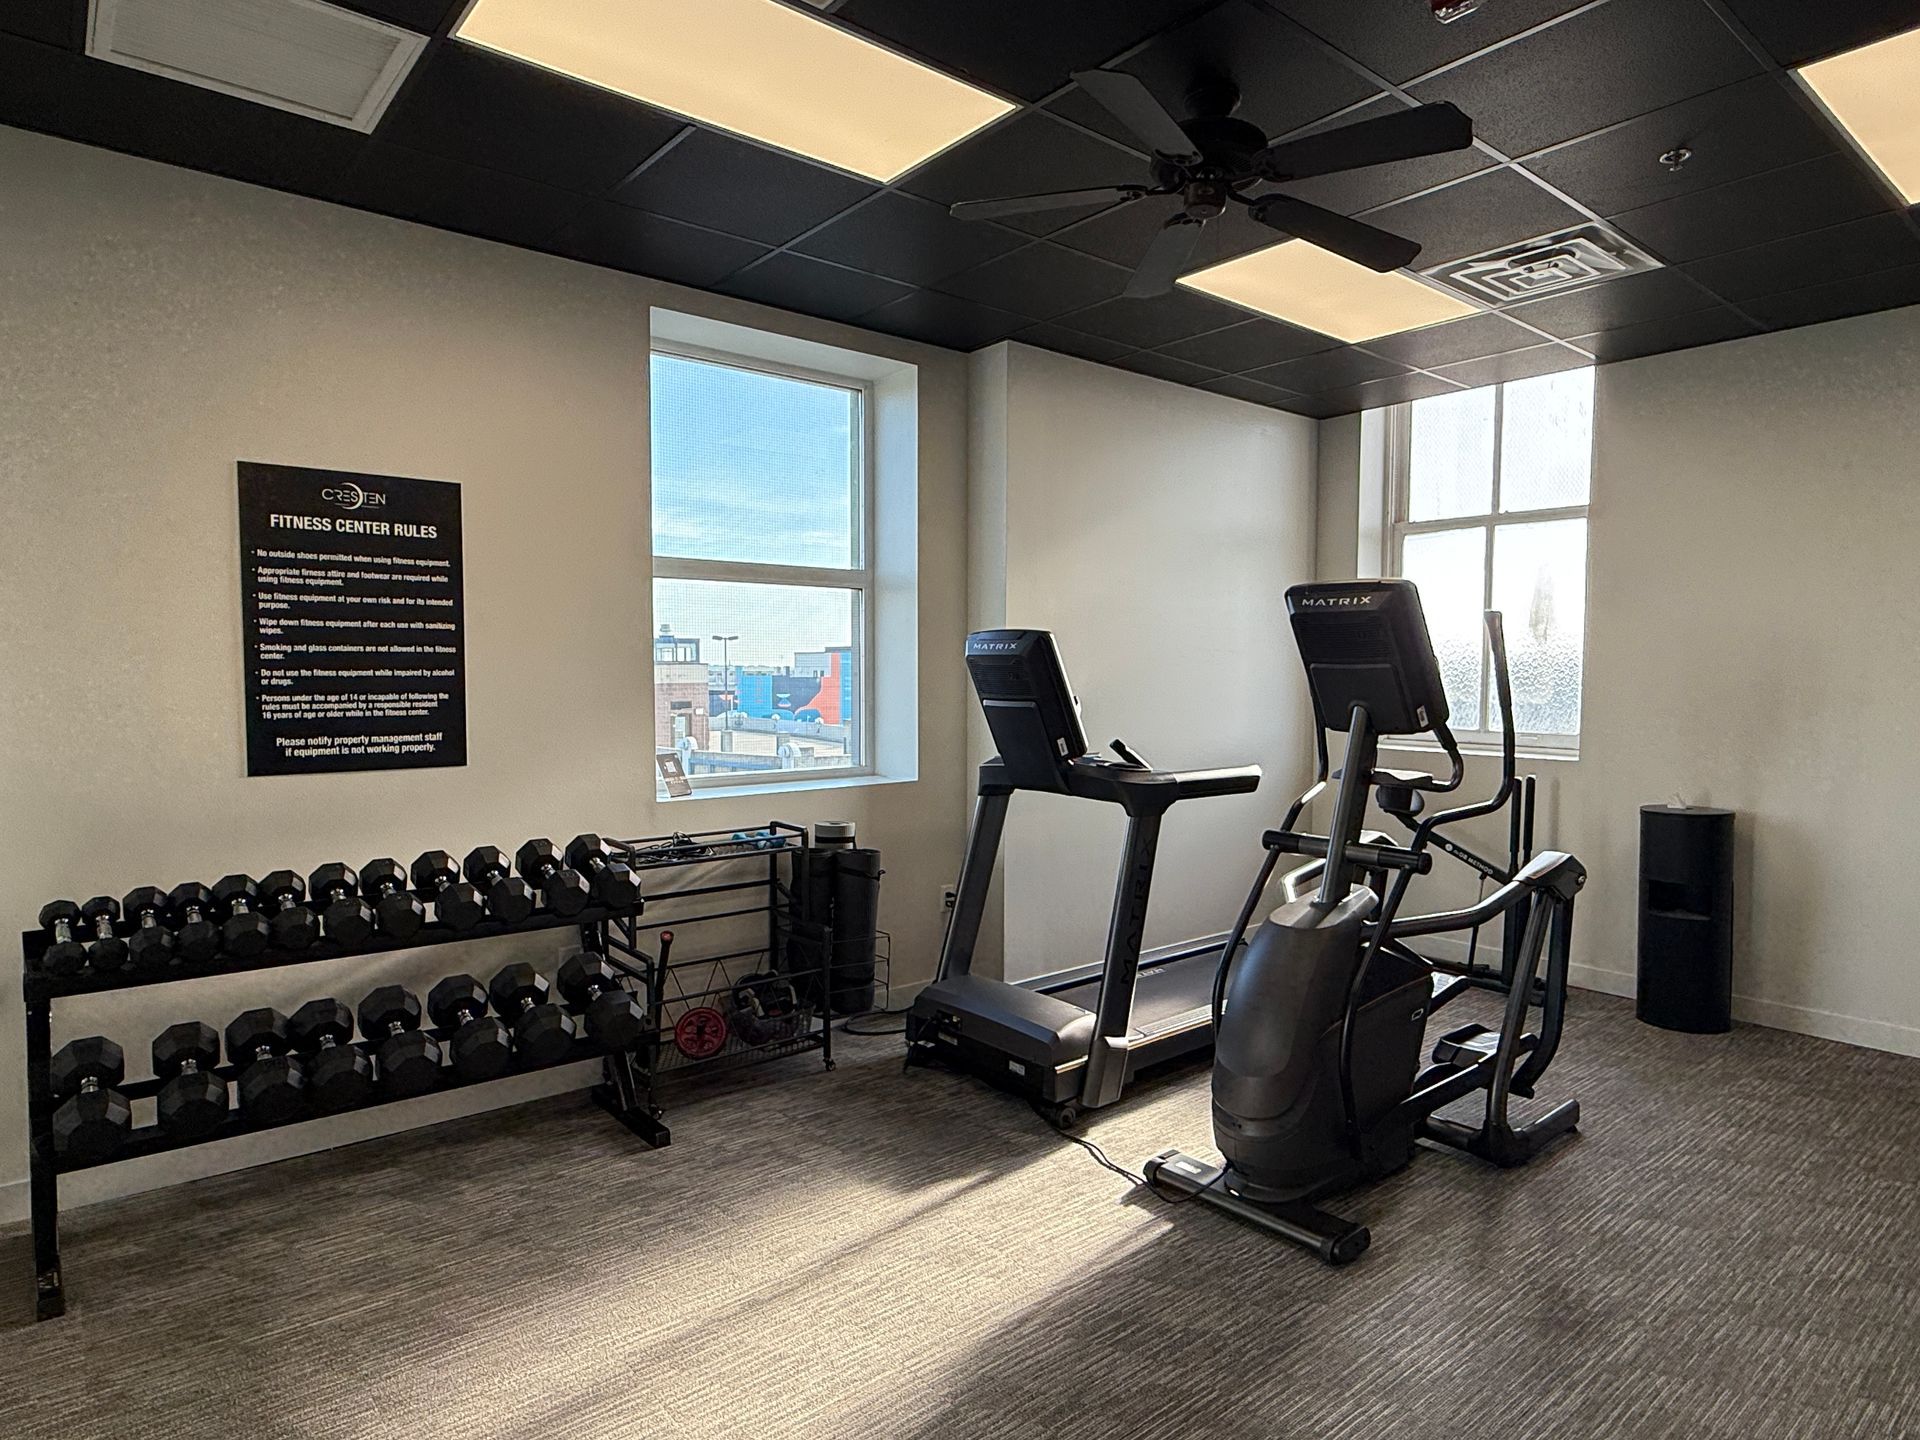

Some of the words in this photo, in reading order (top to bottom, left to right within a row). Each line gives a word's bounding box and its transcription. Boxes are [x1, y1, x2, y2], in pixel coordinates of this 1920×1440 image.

[270, 514, 332, 531] FITNESS
[336, 519, 390, 535] CENTER
[395, 523, 437, 538] RULES
[373, 557, 391, 565] using
[393, 557, 414, 565] fitness
[416, 559, 450, 567] equipment.
[258, 567, 300, 575] Appropriate
[361, 572, 390, 580] footwear
[258, 576, 278, 584] using
[280, 576, 304, 584] fitness
[305, 578, 344, 586] equipment.
[299, 594, 336, 602] equipment
[1301, 596, 1372, 606] MATRIX
[259, 618, 277, 626] Wipe
[326, 620, 361, 628] equipment
[260, 643, 292, 652] Smoking
[394, 669, 422, 677] impaired
[271, 678, 293, 686] drugs.
[276, 738, 305, 746] Please
[308, 736, 332, 745] notify
[334, 736, 369, 745] property
[371, 734, 423, 743] management
[425, 732, 442, 741] staff
[285, 748, 292, 757] if
[294, 747, 339, 757] equipment
[367, 745, 400, 753] working
[402, 744, 435, 752] properly.
[1120, 837, 1153, 985] MATRIX
